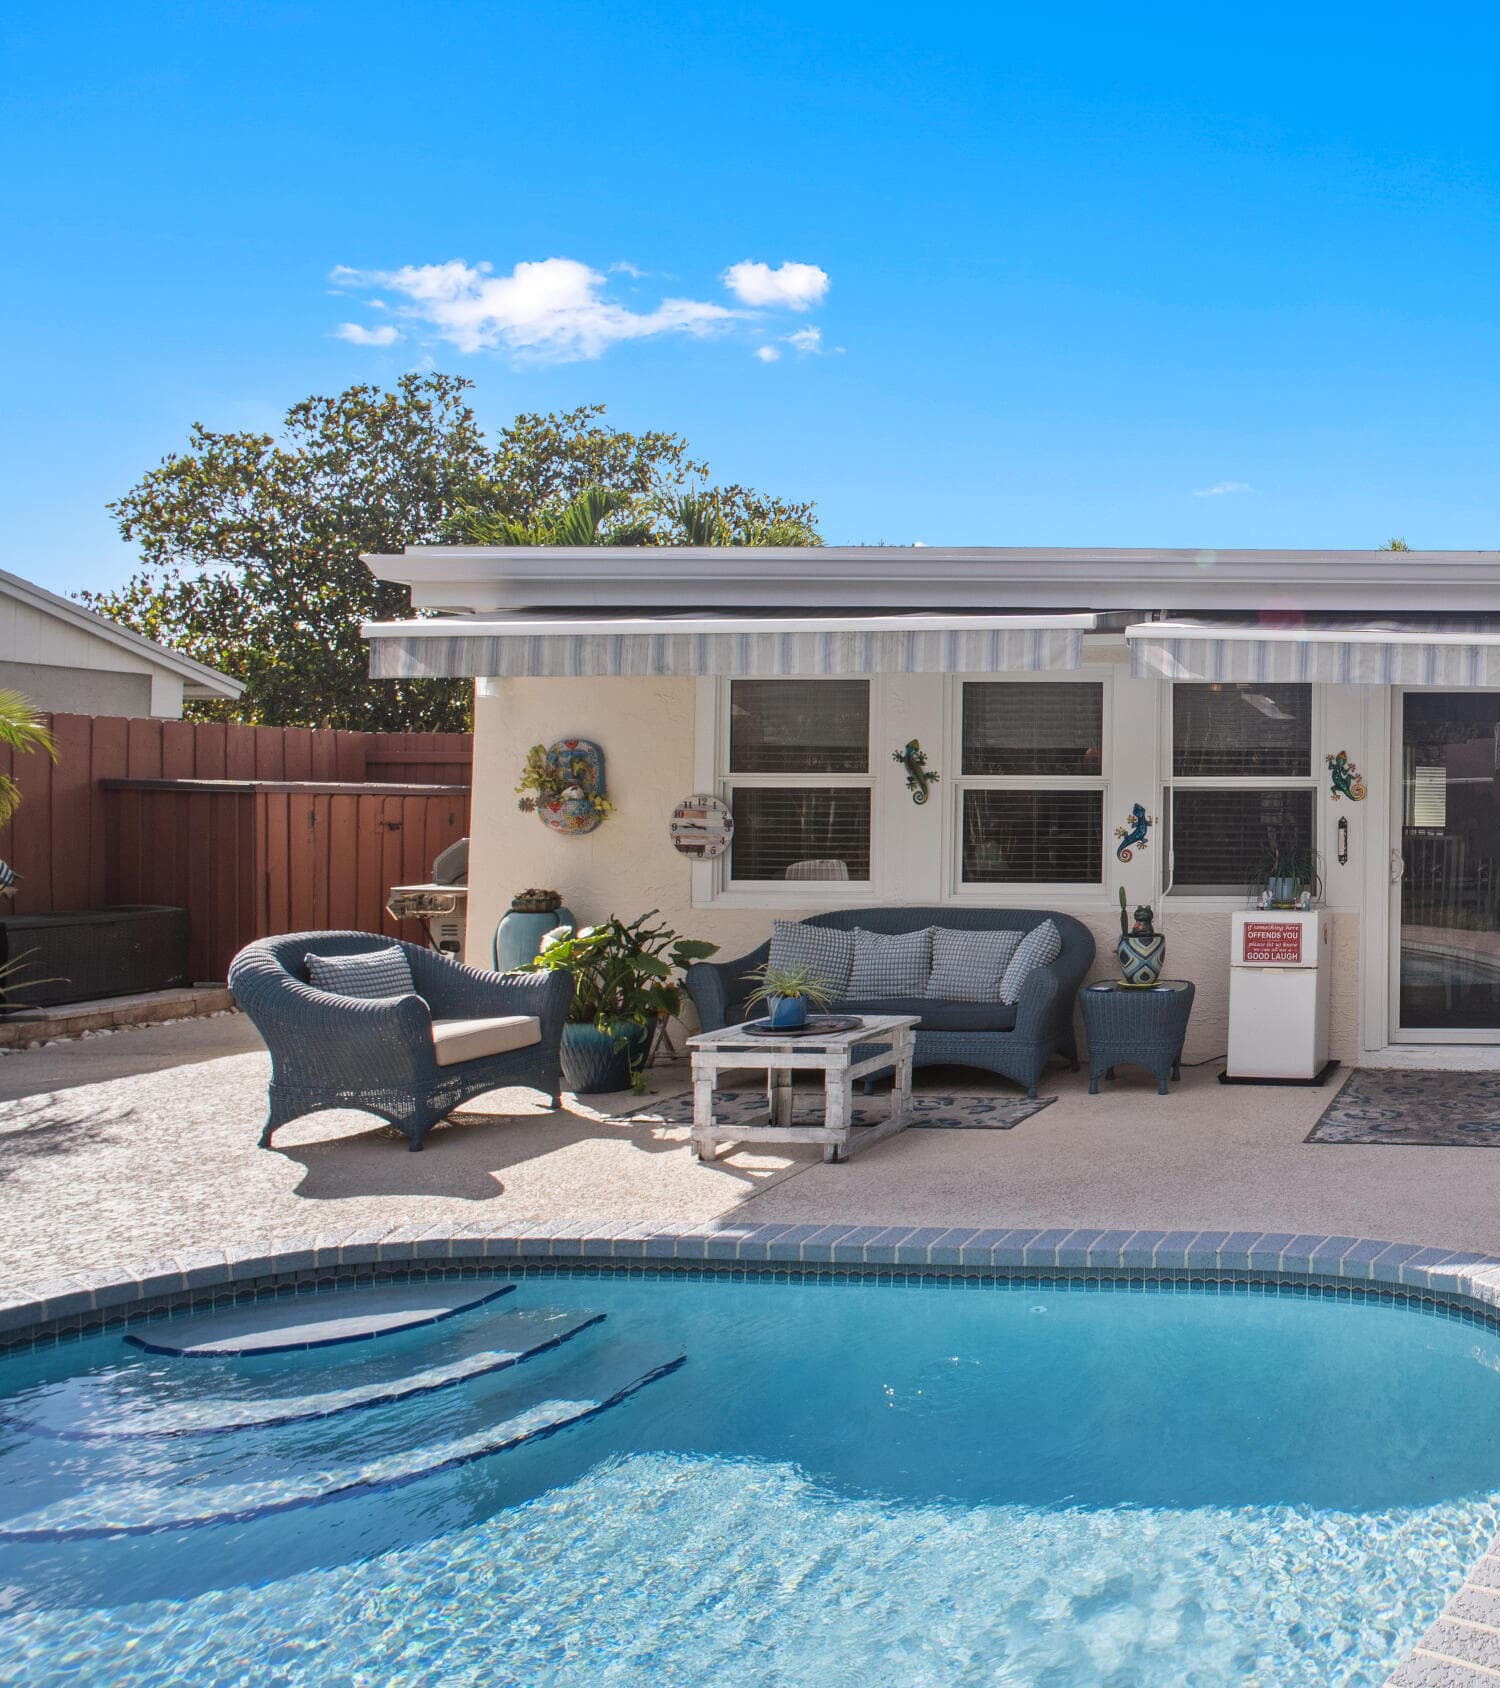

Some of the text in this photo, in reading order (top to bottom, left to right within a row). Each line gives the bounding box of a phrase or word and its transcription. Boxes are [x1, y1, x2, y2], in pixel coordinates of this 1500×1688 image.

[684, 801, 692, 809] 11
[698, 797, 708, 806] 12
[674, 809, 684, 819] 10
[721, 810, 728, 820] 2
[671, 822, 678, 832] 9
[675, 835, 681, 845] 8
[710, 846, 717, 855] 5
[1247, 931, 1298, 939] OFFENDS YOU
[1247, 952, 1298, 960] GOOD LAUGH
